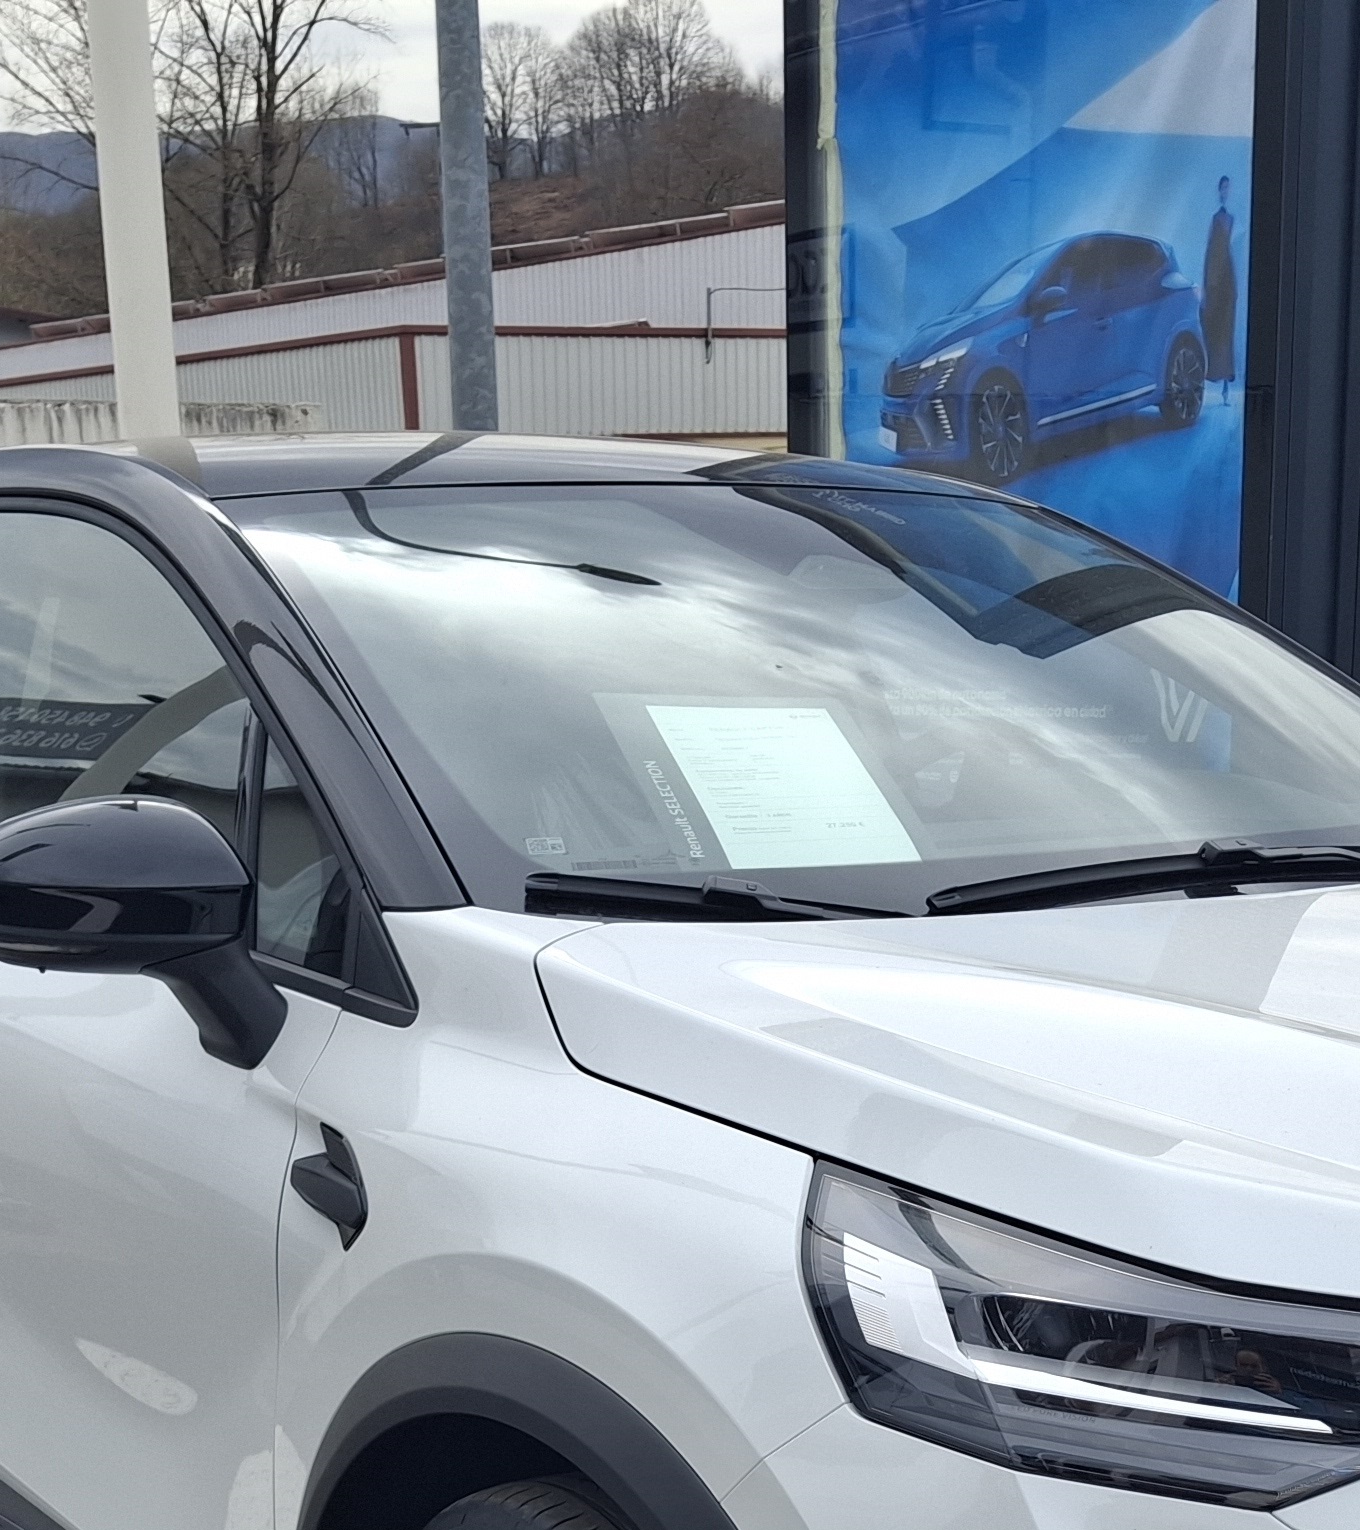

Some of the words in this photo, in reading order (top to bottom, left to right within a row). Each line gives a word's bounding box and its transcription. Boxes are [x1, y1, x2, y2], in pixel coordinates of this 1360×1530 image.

[643, 760, 684, 815] SELECTION
[675, 817, 705, 858] Renault
[1062, 1411, 1096, 1423] VISION
